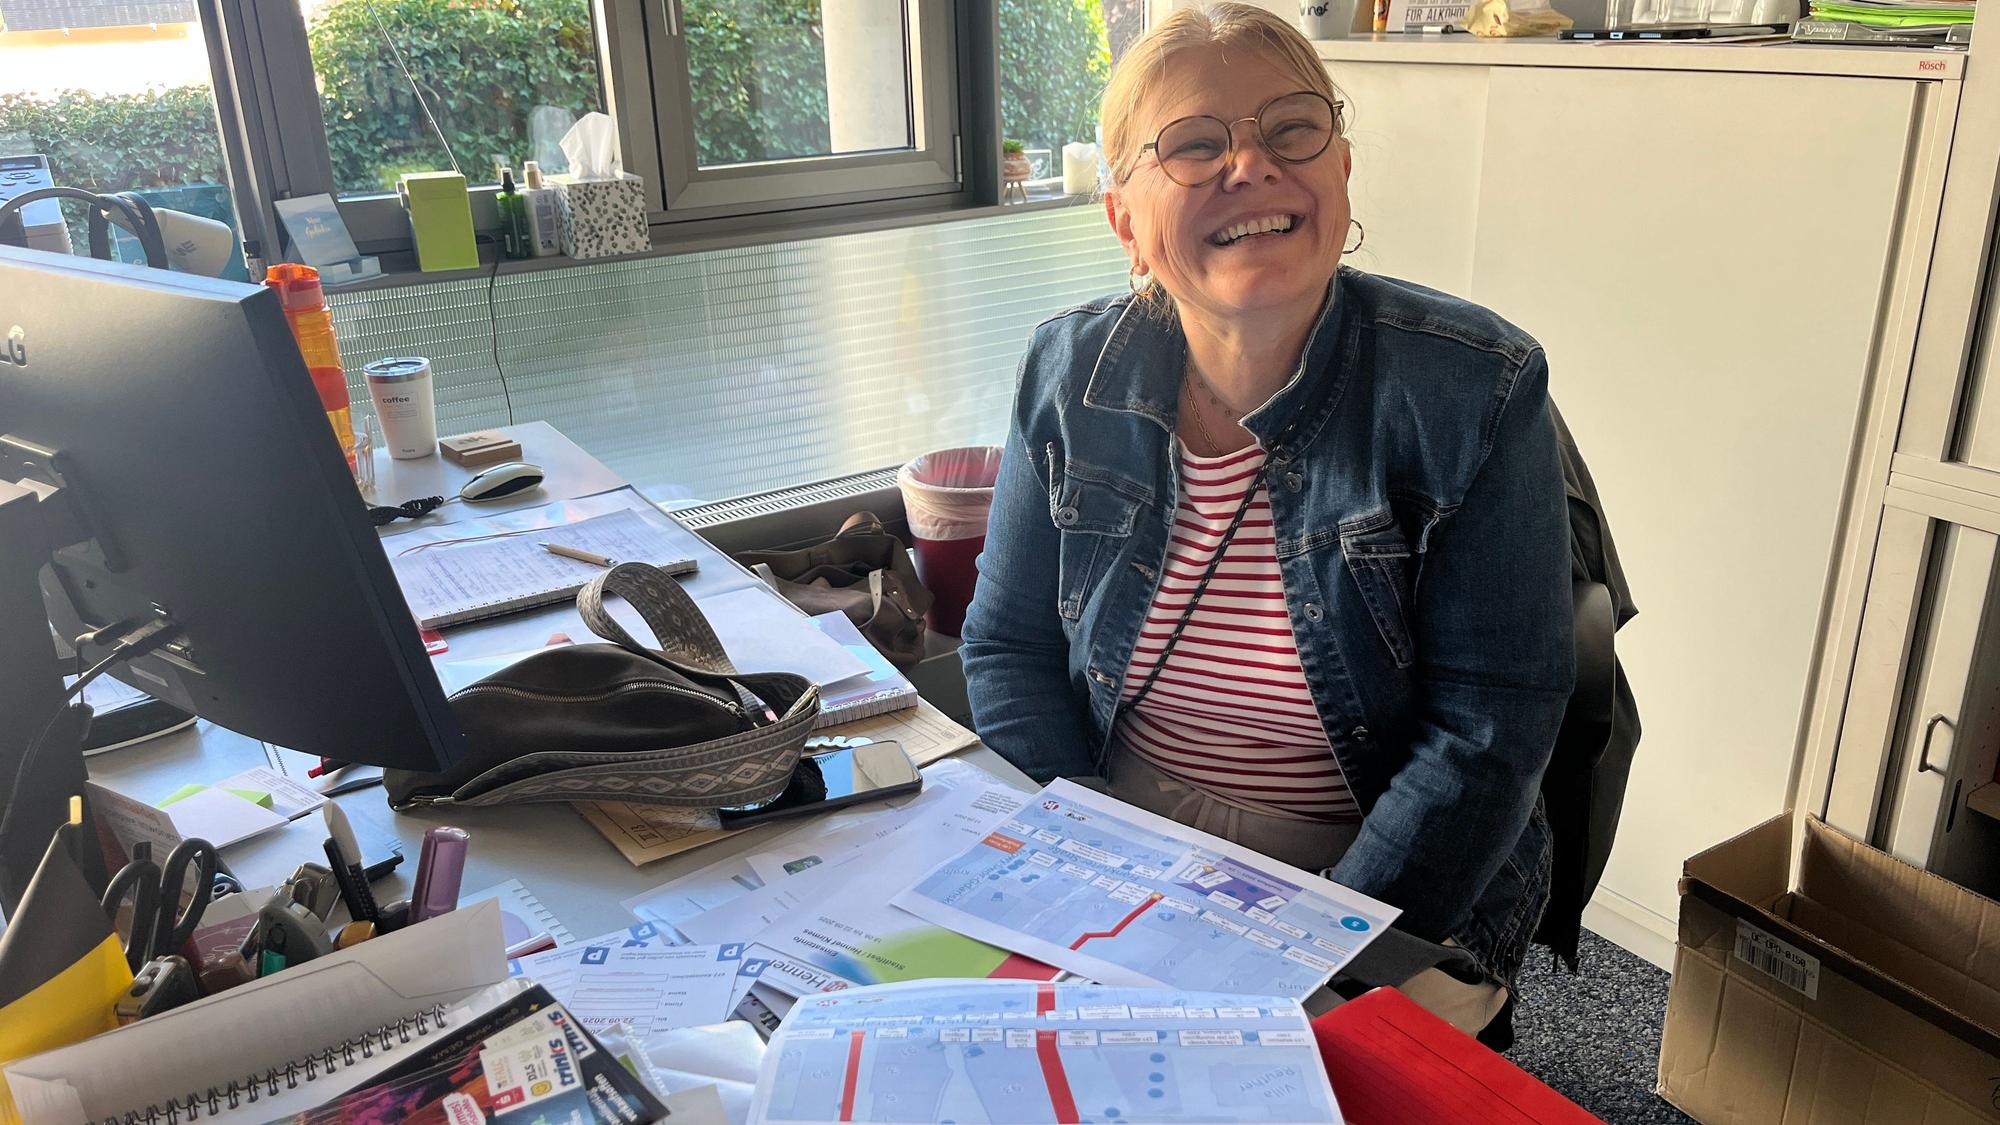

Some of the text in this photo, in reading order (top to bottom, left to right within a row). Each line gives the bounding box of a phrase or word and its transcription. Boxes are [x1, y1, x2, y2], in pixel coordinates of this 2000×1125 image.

[1919, 60, 1946, 72] Rösch
[382, 396, 410, 404] coffee
[803, 929, 831, 945] Kirmes
[793, 936, 838, 957] Einsatzinfo
[831, 939, 862, 956] Hennef
[866, 949, 906, 971] Stadtfest
[549, 1038, 575, 1087] trinks
[1239, 1065, 1296, 1093] Reuther
[1263, 1083, 1296, 1099] Villa
